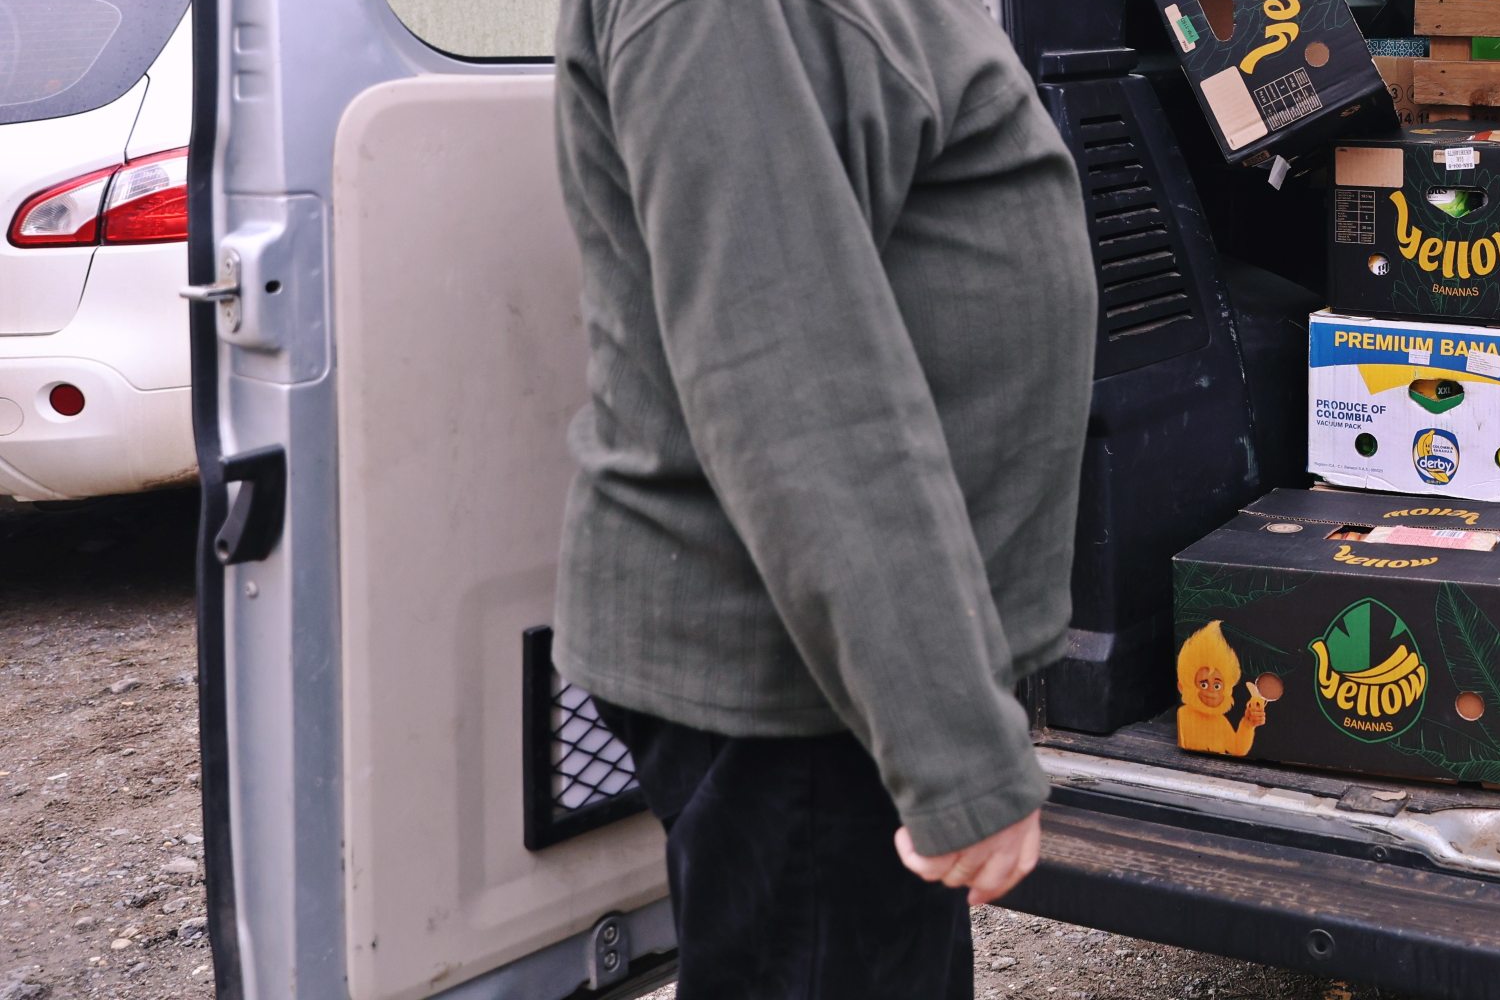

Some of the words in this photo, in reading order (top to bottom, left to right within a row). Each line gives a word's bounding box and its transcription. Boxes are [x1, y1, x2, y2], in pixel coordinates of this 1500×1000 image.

[1432, 283, 1479, 297] BANANAS
[1334, 330, 1433, 355] PREMIUM
[1316, 399, 1368, 413] PRODUCE
[1371, 404, 1387, 415] OF
[1316, 409, 1374, 423] COLOMBIA
[1344, 422, 1362, 430] PACK
[1419, 455, 1453, 472] derby
[1343, 716, 1394, 732] BANANAS
